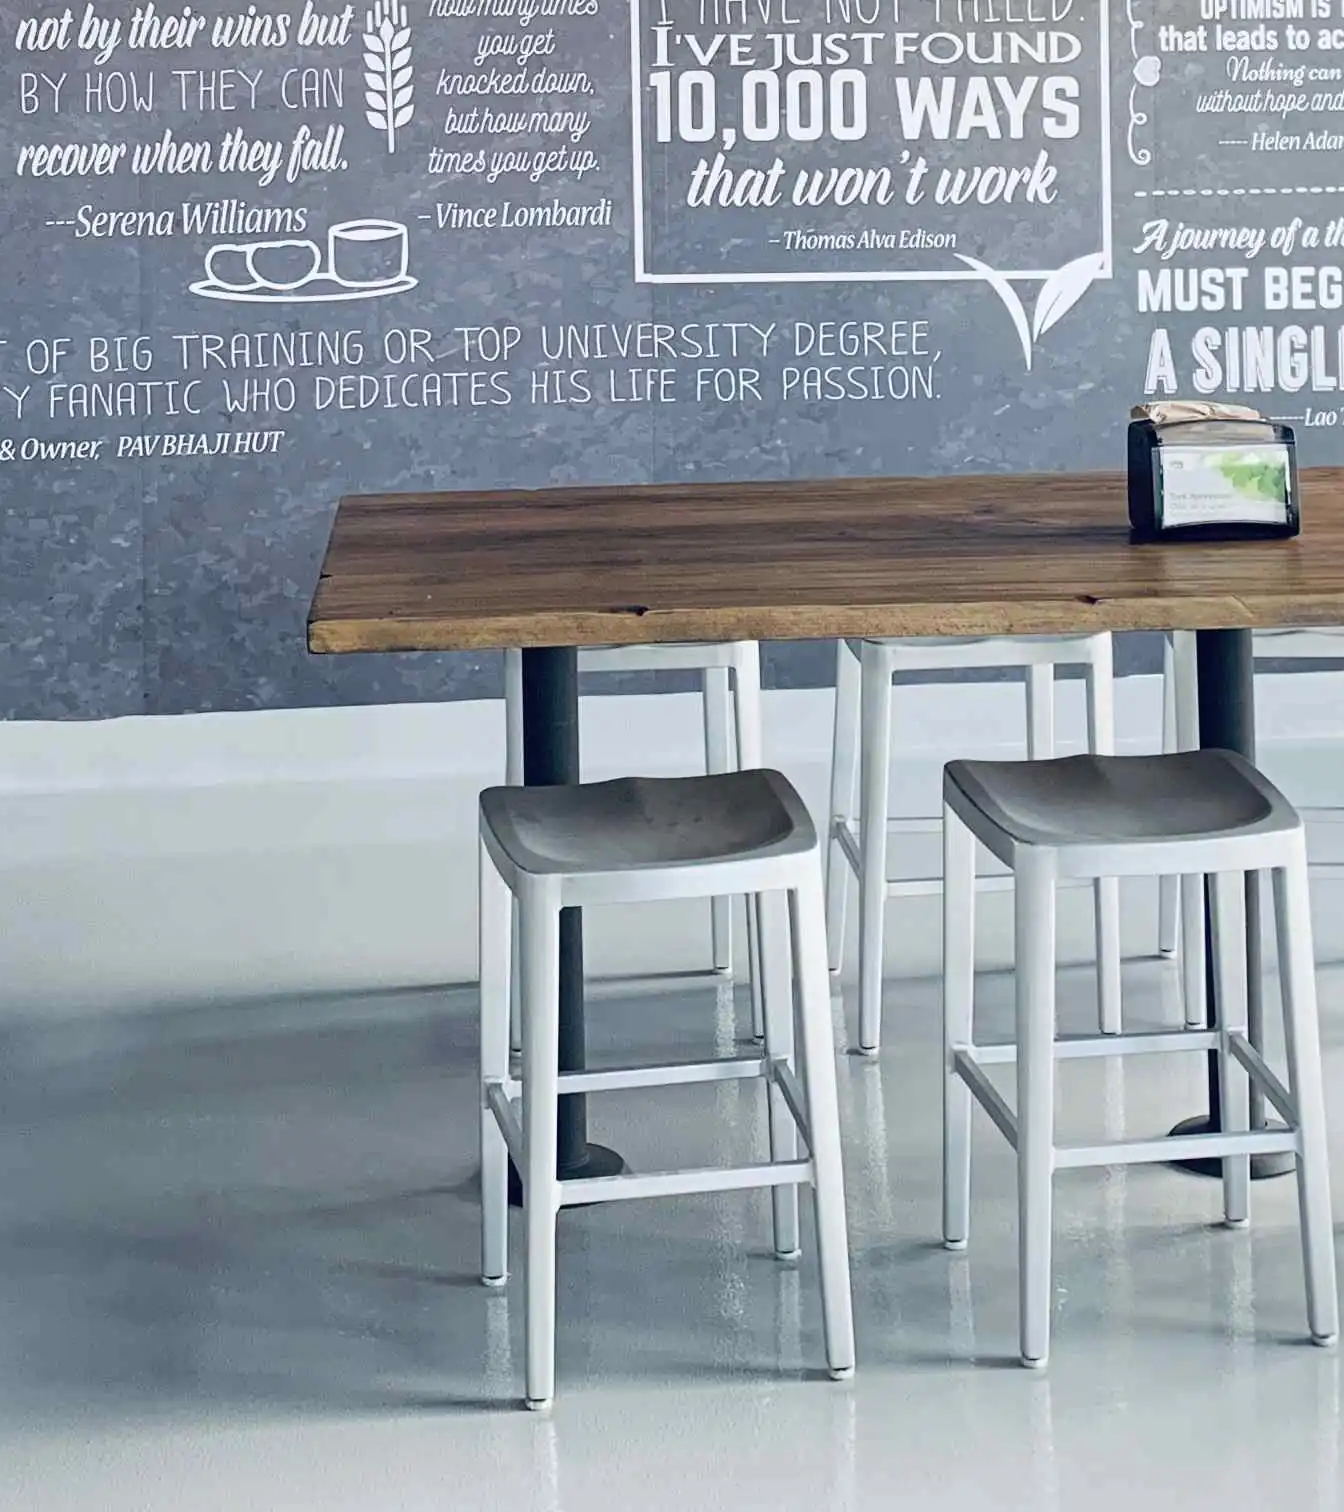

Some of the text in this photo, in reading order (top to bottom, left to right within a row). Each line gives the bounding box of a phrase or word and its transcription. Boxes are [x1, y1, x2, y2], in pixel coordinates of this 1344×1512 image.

[1157, 24, 1208, 52] that
[1215, 23, 1279, 51] leads
[1285, 24, 1311, 50] to
[650, 68, 1080, 151] 10,000 WAYS
[1137, 267, 1249, 313] MUST
